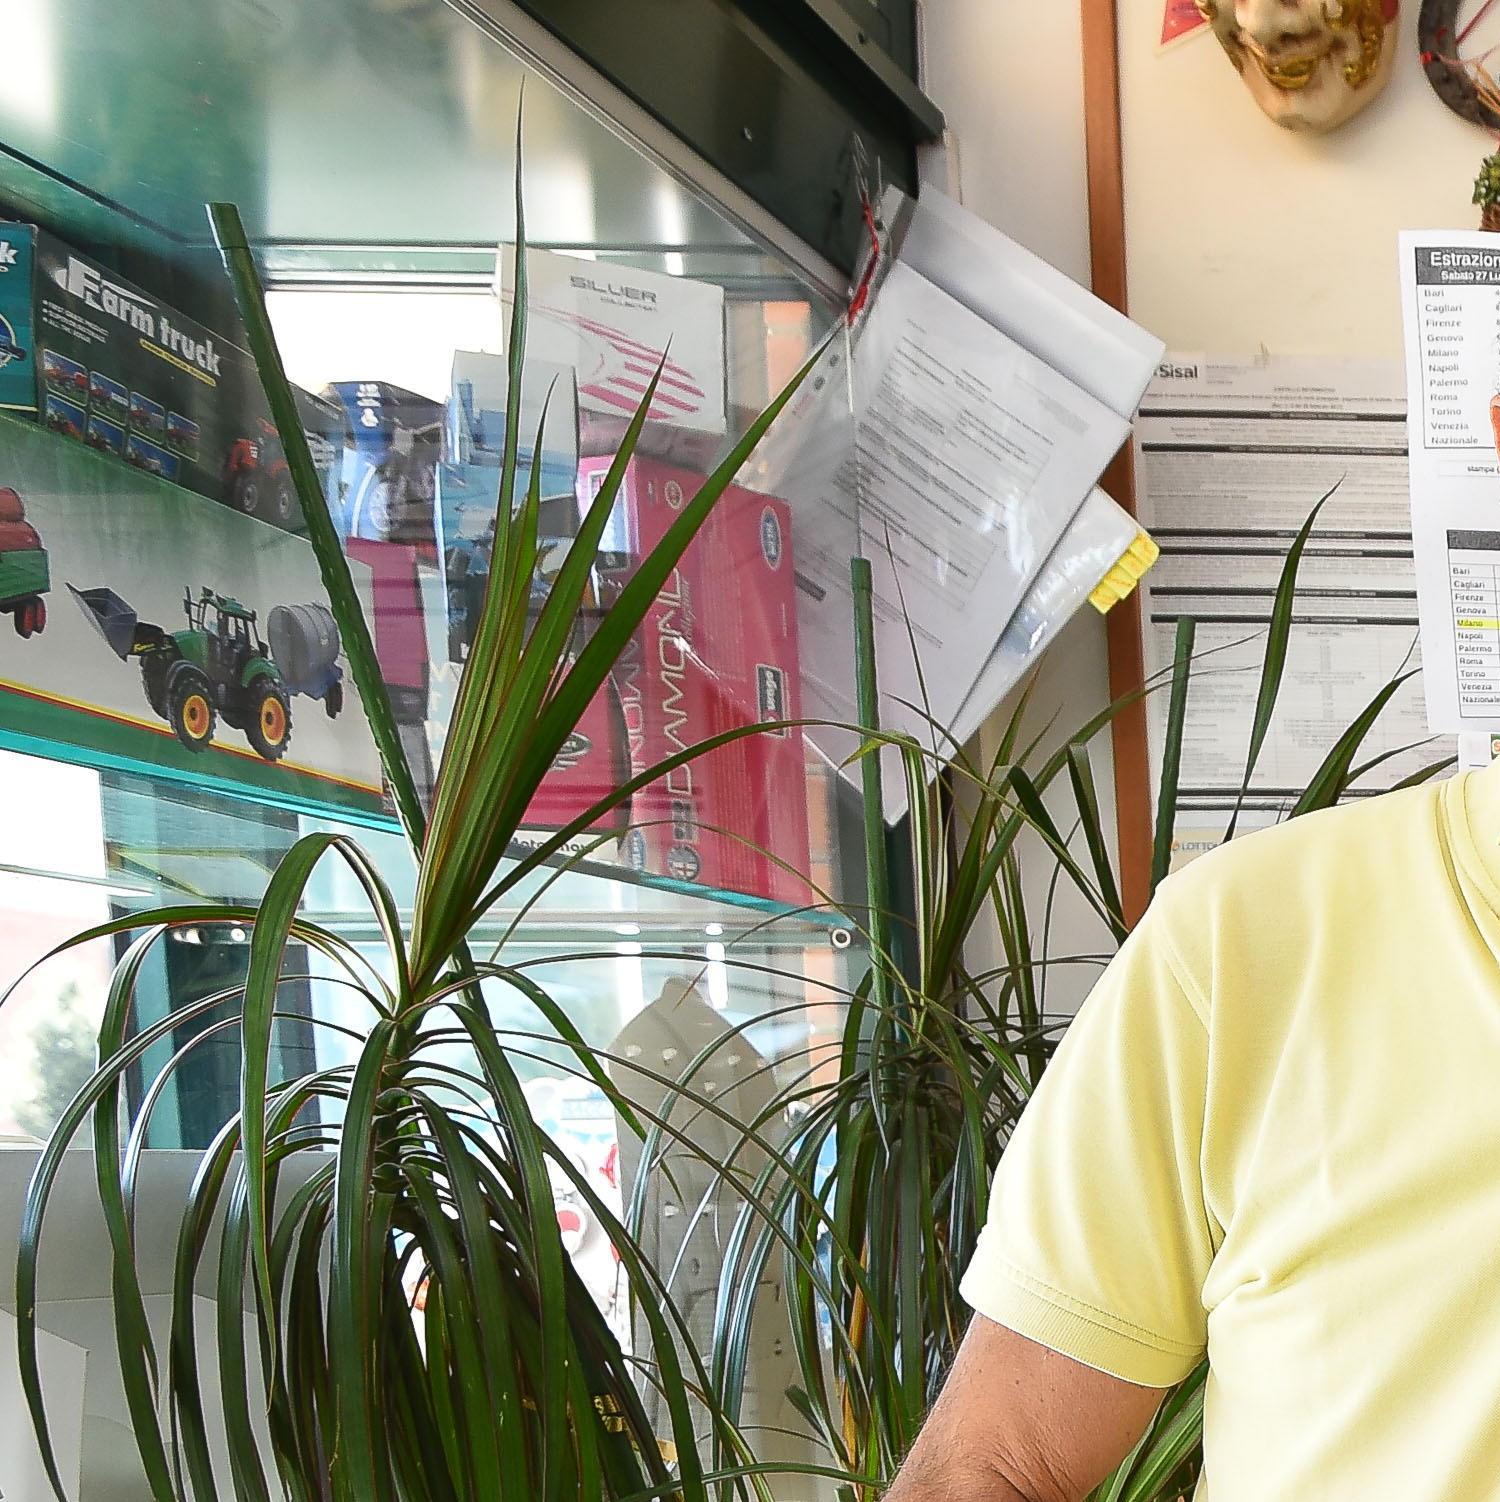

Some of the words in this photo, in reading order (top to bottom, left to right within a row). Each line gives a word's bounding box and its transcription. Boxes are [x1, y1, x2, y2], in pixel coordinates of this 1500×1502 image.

[54, 256, 157, 338] Farm
[160, 316, 222, 377] truck
[1159, 363, 1199, 380] Sisal
